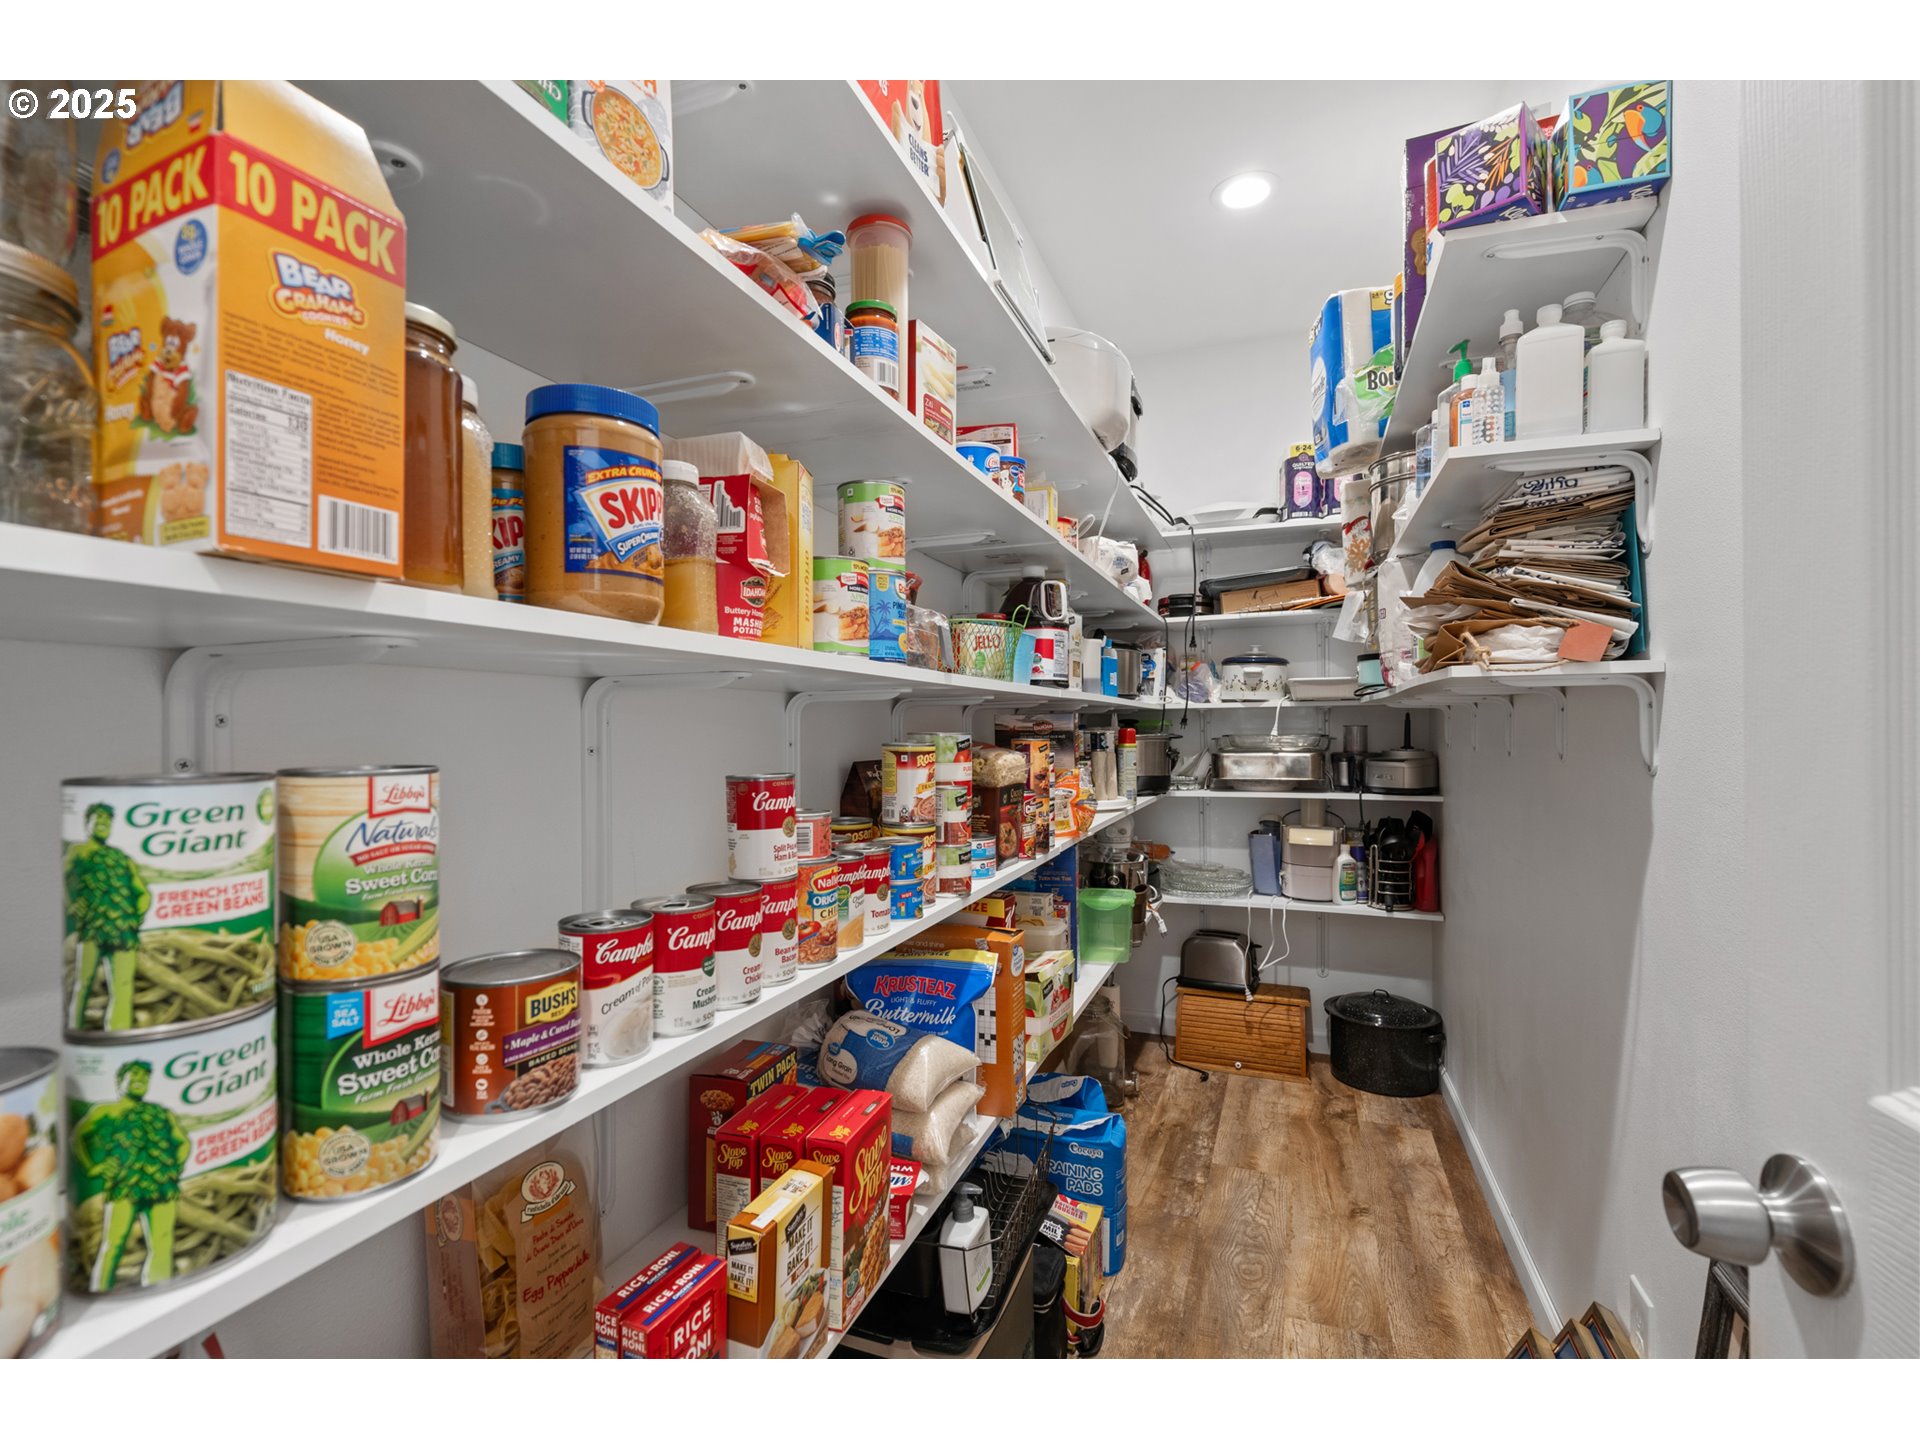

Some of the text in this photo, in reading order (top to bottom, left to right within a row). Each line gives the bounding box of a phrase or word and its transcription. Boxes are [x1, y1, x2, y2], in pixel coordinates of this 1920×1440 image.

[908, 133, 928, 163] CLEANS
[909, 148, 930, 177] BETTER
[97, 194, 122, 248] 10
[128, 145, 208, 232] PACK
[227, 151, 277, 218] 10
[291, 182, 398, 276] PACK
[274, 253, 353, 300] BEAR
[323, 327, 370, 356] Honey
[586, 466, 629, 484] EXTRA
[599, 487, 663, 530] SKIPP
[616, 534, 641, 556] SUPER
[743, 585, 767, 598] IDAHOA
[724, 605, 751, 617] Buttery
[733, 616, 764, 628] MASHE
[733, 626, 762, 637] POTATO
[378, 783, 425, 805] Libby's
[126, 801, 245, 829] Green
[141, 827, 249, 858] Giant
[345, 815, 438, 853] Naturals
[156, 878, 265, 905] FRENCH STYLE
[345, 872, 408, 896] Sweet
[155, 890, 266, 920] GREEN BEANS
[871, 908, 891, 918] Tomat
[775, 946, 791, 956] Bean
[781, 953, 797, 963] Bacon
[782, 967, 796, 976] SOUP
[873, 974, 957, 1000] KRUSTEAZ
[334, 1008, 358, 1019] SEA
[377, 988, 436, 1027] Libby's
[530, 985, 577, 1020] BUSH'S
[550, 1009, 565, 1018] BEST
[601, 988, 636, 1016] Cream
[865, 998, 957, 1025] Buttermilk
[890, 996, 909, 1004] LIGHT
[916, 998, 937, 1006] FLUFFY
[331, 1016, 360, 1028] SALT
[509, 1031, 540, 1052] Maple
[541, 1029, 548, 1040] &
[549, 1021, 570, 1038] Cured
[164, 1034, 266, 1080] Green
[352, 1043, 412, 1070] Whole
[528, 1050, 558, 1068] BAKED
[558, 1043, 578, 1055] BEANS
[826, 1055, 838, 1067] Long
[838, 1061, 852, 1074] Grain
[181, 1059, 267, 1105] Giant
[337, 1055, 419, 1097] Sweet
[749, 1051, 797, 1097] TWIN PACK
[197, 1118, 256, 1149] FRENCH
[195, 1134, 251, 1165] GREEN
[717, 1144, 748, 1164] Stove
[762, 1147, 794, 1168] Stove
[812, 1150, 841, 1165] Stove
[727, 1156, 743, 1170] Top
[773, 1160, 789, 1174] Top
[849, 1125, 888, 1215] Stove
[1048, 1159, 1104, 1181] RAINING
[863, 1160, 883, 1215] Top
[1065, 1177, 1104, 1196] PADS
[863, 1196, 884, 1235] TURKEY
[787, 1215, 814, 1253] MAKE IT
[1043, 1223, 1059, 1235] MIL
[731, 1261, 754, 1275] MAKE IT
[786, 1237, 814, 1276] BAKE IT!
[617, 1249, 681, 1298] RICE RONI
[730, 1273, 745, 1284] BAKE
[523, 1283, 545, 1304] Egg
[642, 1262, 706, 1314] RICE RONI
[595, 1311, 617, 1327] RICE
[595, 1322, 619, 1339] RONI
[673, 1300, 711, 1350] RICE
[621, 1326, 645, 1342] RICE
[622, 1337, 647, 1354] RONI
[684, 1329, 711, 1359] ONI
